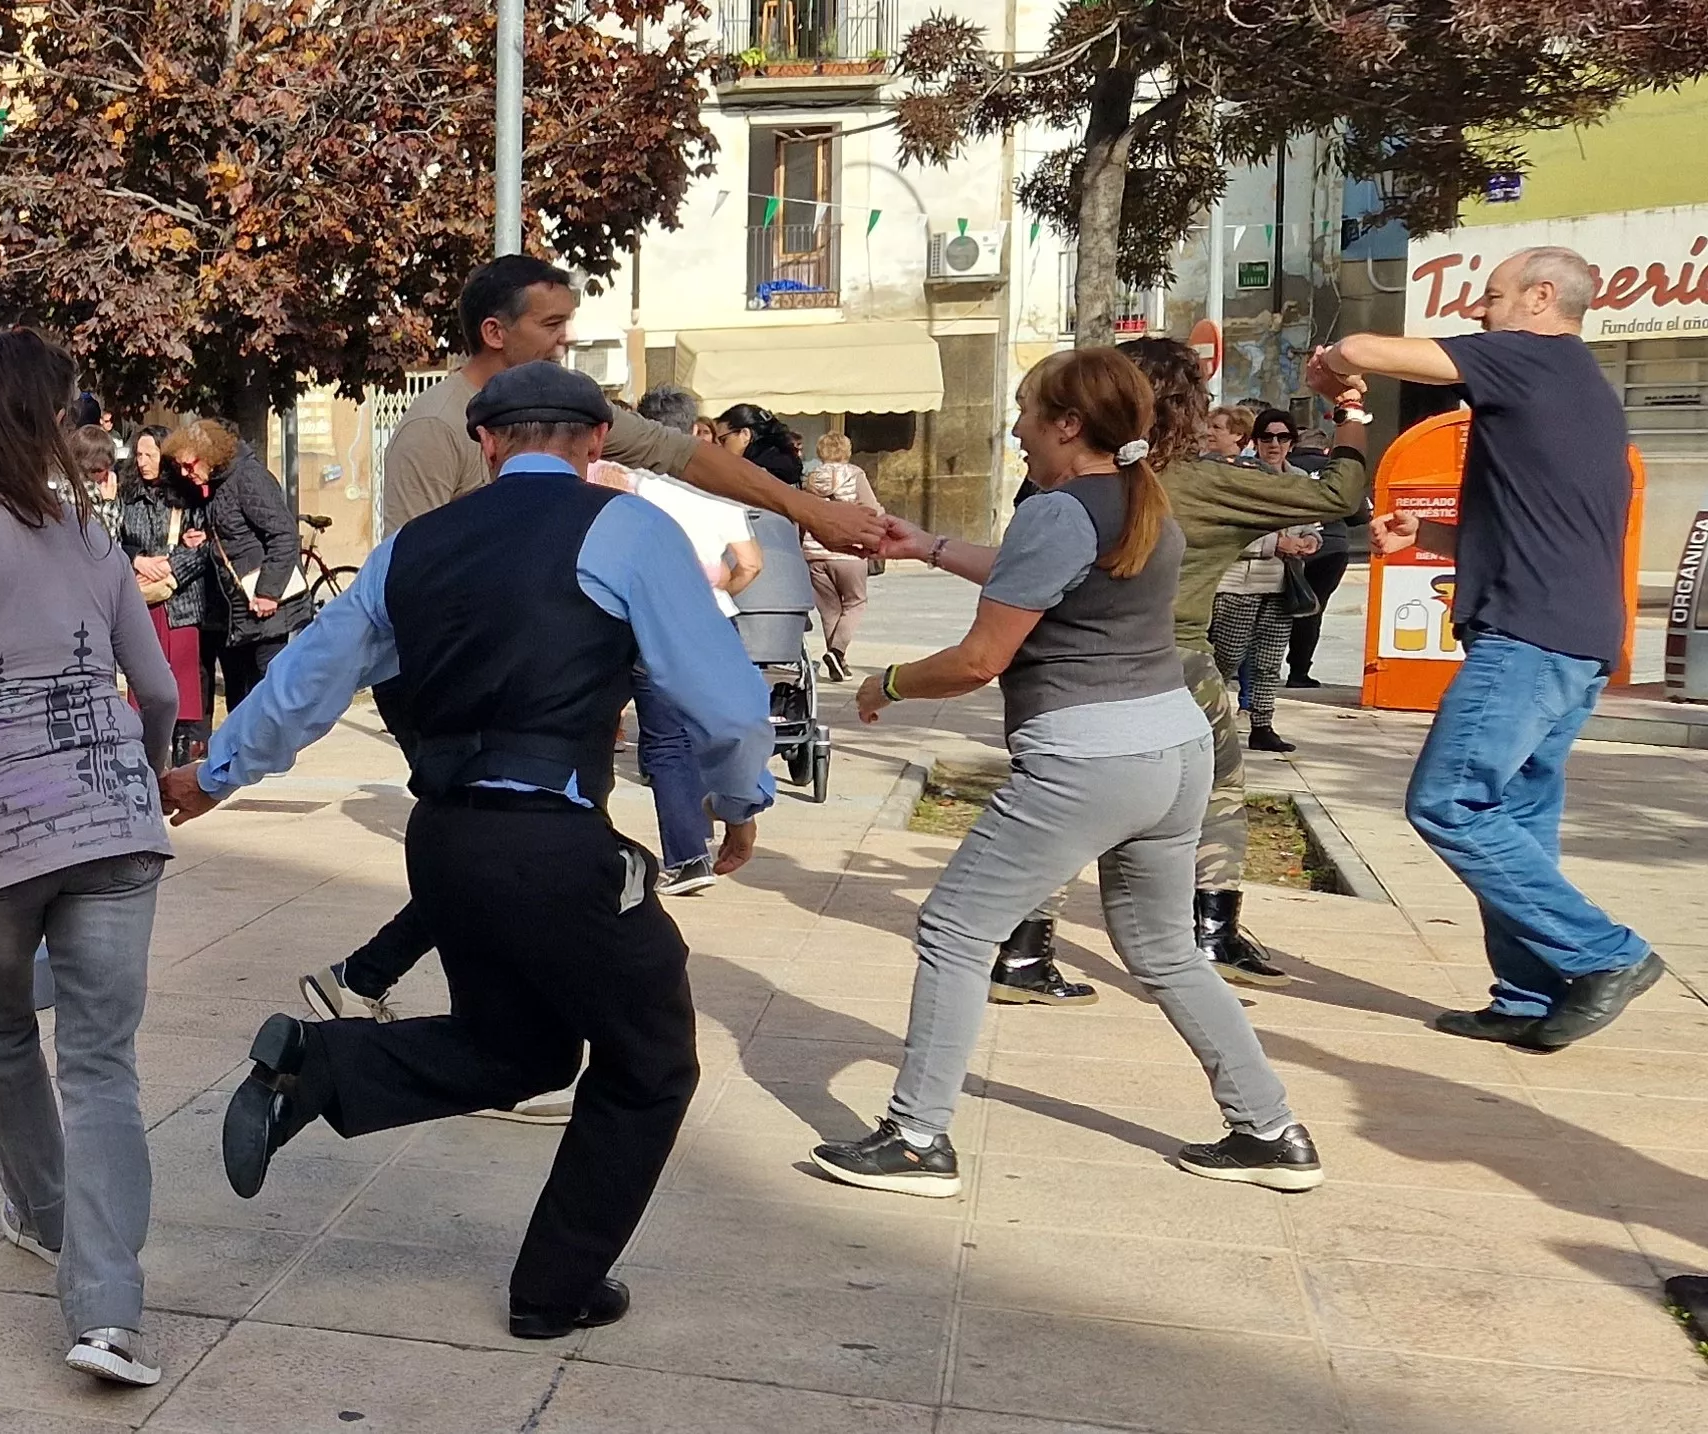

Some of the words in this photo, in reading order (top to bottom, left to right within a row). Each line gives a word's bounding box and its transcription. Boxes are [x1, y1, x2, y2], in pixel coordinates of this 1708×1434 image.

[1600, 317, 1663, 335] Fundada
[1666, 315, 1679, 331] el
[1683, 315, 1708, 330] año
[1395, 497, 1457, 507] RECICLADO
[1403, 506, 1459, 518] DOMÉSTIC
[1672, 518, 1708, 623] ORGANICA
